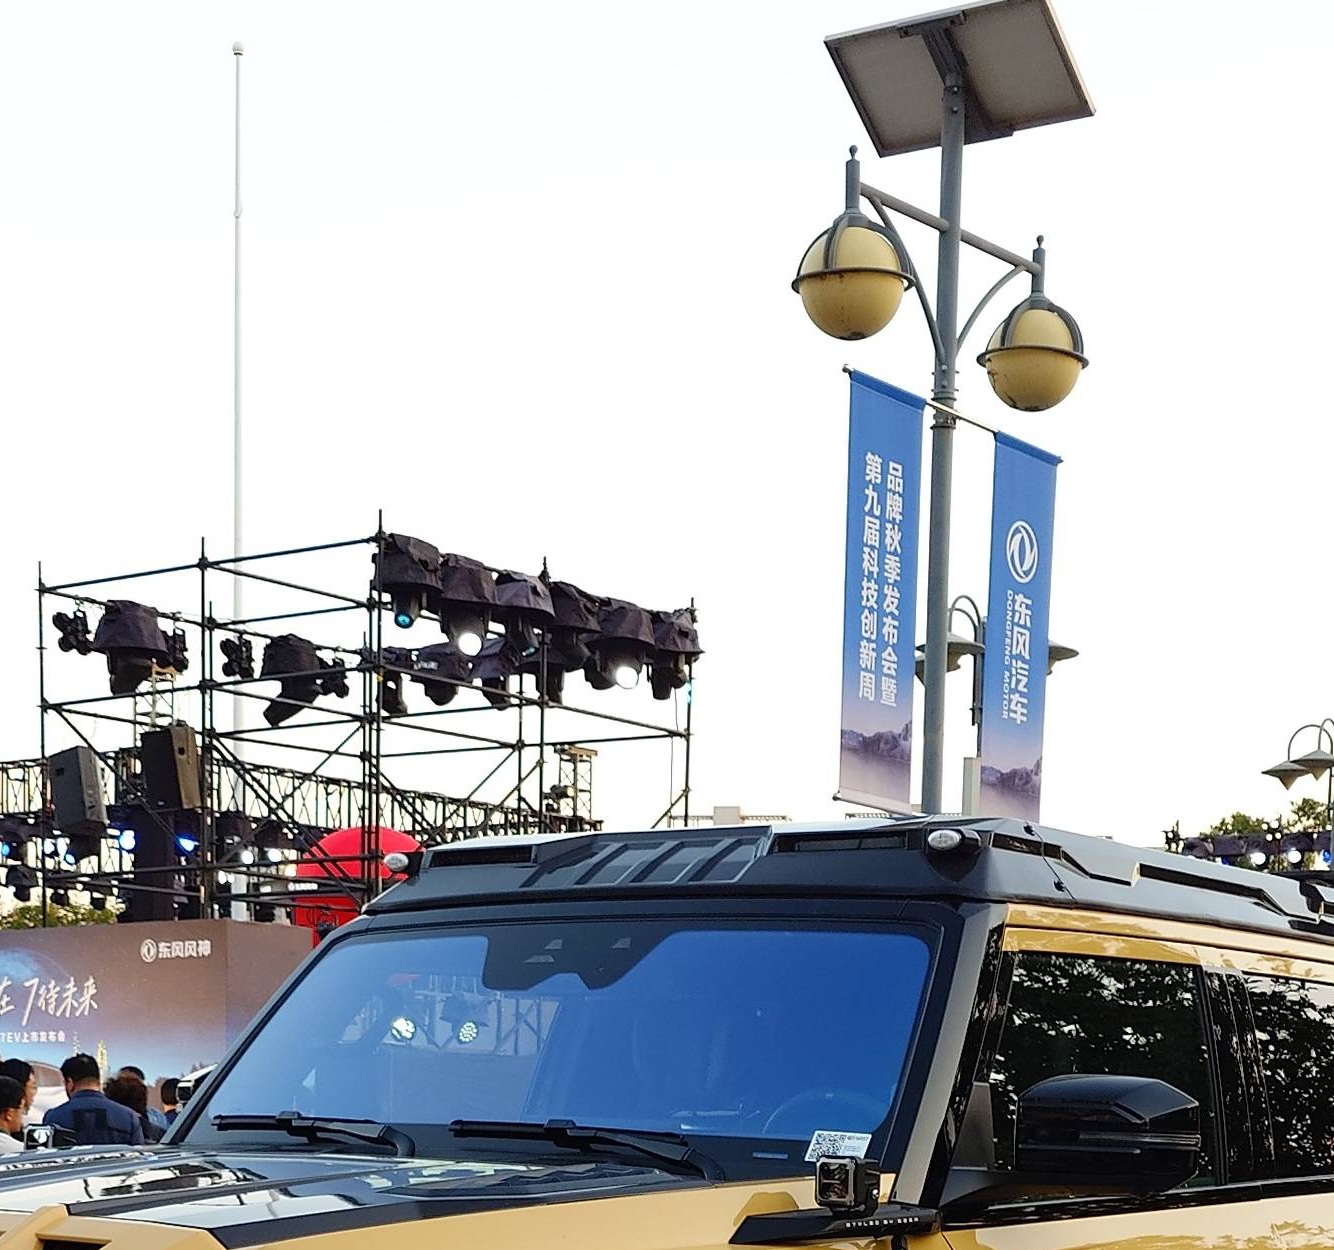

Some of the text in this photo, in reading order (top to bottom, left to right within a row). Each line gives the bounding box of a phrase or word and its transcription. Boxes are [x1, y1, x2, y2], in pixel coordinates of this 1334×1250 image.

[859, 452, 883, 702] 第九届科技创新周
[880, 460, 905, 707] 品牌秋季发布会暨
[1010, 593, 1032, 725] 东风汽车
[158, 940, 211, 958] 东风风神
